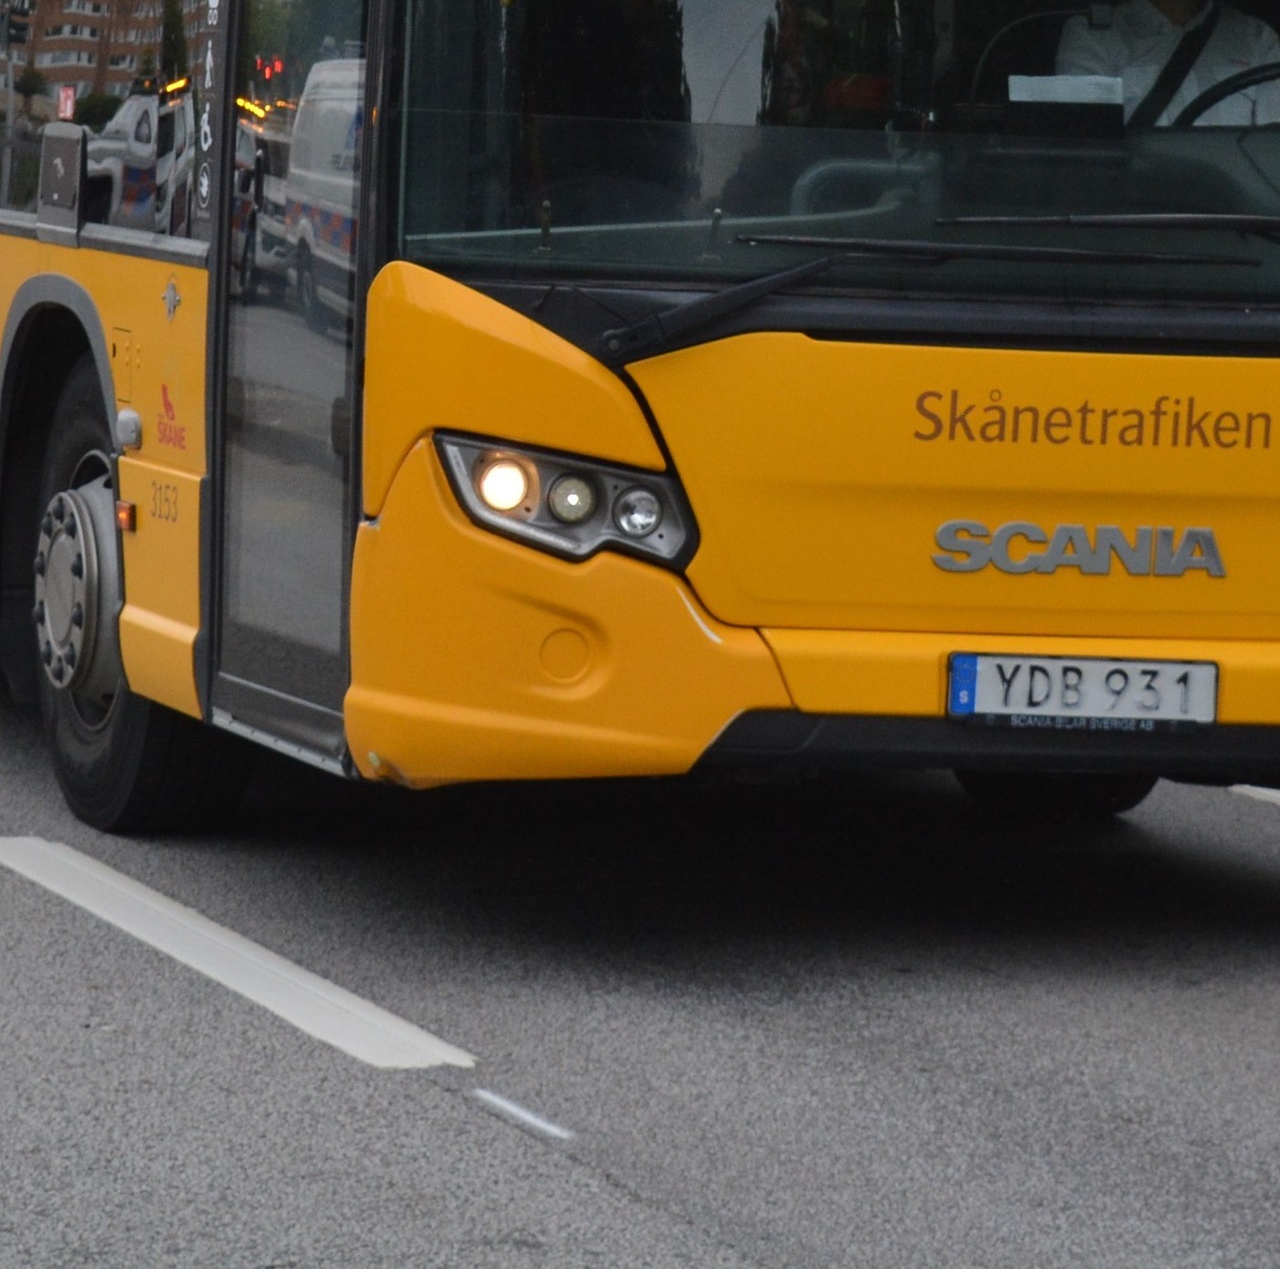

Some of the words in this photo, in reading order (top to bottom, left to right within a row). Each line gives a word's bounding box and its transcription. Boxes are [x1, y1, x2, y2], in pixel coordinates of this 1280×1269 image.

[914, 389, 1273, 449] Skånetrafiken
[150, 480, 178, 522] 3153
[930, 518, 1227, 578] SCANIA
[996, 662, 1084, 708] YDB
[1104, 667, 1191, 715] 931
